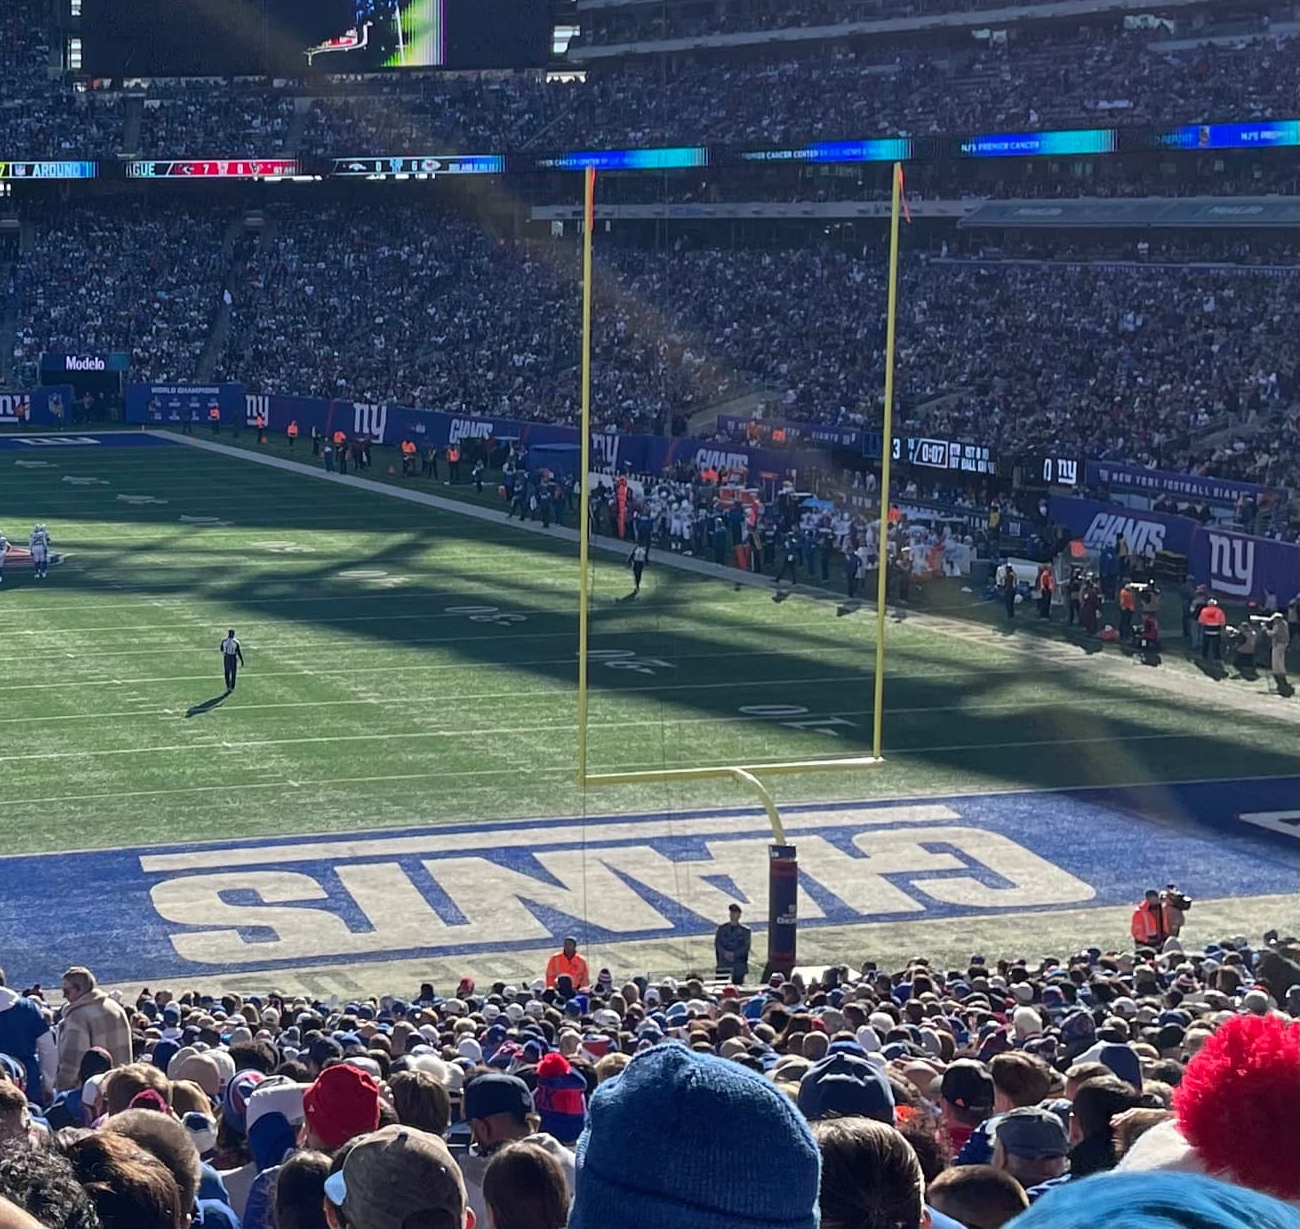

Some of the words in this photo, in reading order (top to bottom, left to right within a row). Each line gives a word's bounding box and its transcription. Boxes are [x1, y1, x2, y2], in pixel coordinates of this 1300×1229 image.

[766, 151, 792, 159] CANCER
[1010, 141, 1039, 150] CANCER
[66, 355, 105, 371] Modelo
[246, 395, 269, 427] ny
[353, 403, 387, 444] ny
[449, 418, 493, 444] GIANTS
[696, 448, 749, 472] GIANTS
[893, 438, 901, 459] 3
[922, 443, 944, 464] 0:07
[1057, 459, 1077, 485] ny
[1112, 472, 1132, 484] NEW
[1135, 474, 1159, 488] YORK
[1163, 478, 1210, 495] FOOTBALL
[1083, 513, 1166, 559] GIANTS
[1209, 532, 1254, 596] ny
[739, 704, 858, 728] 10
[139, 804, 1097, 965] GIANTS
